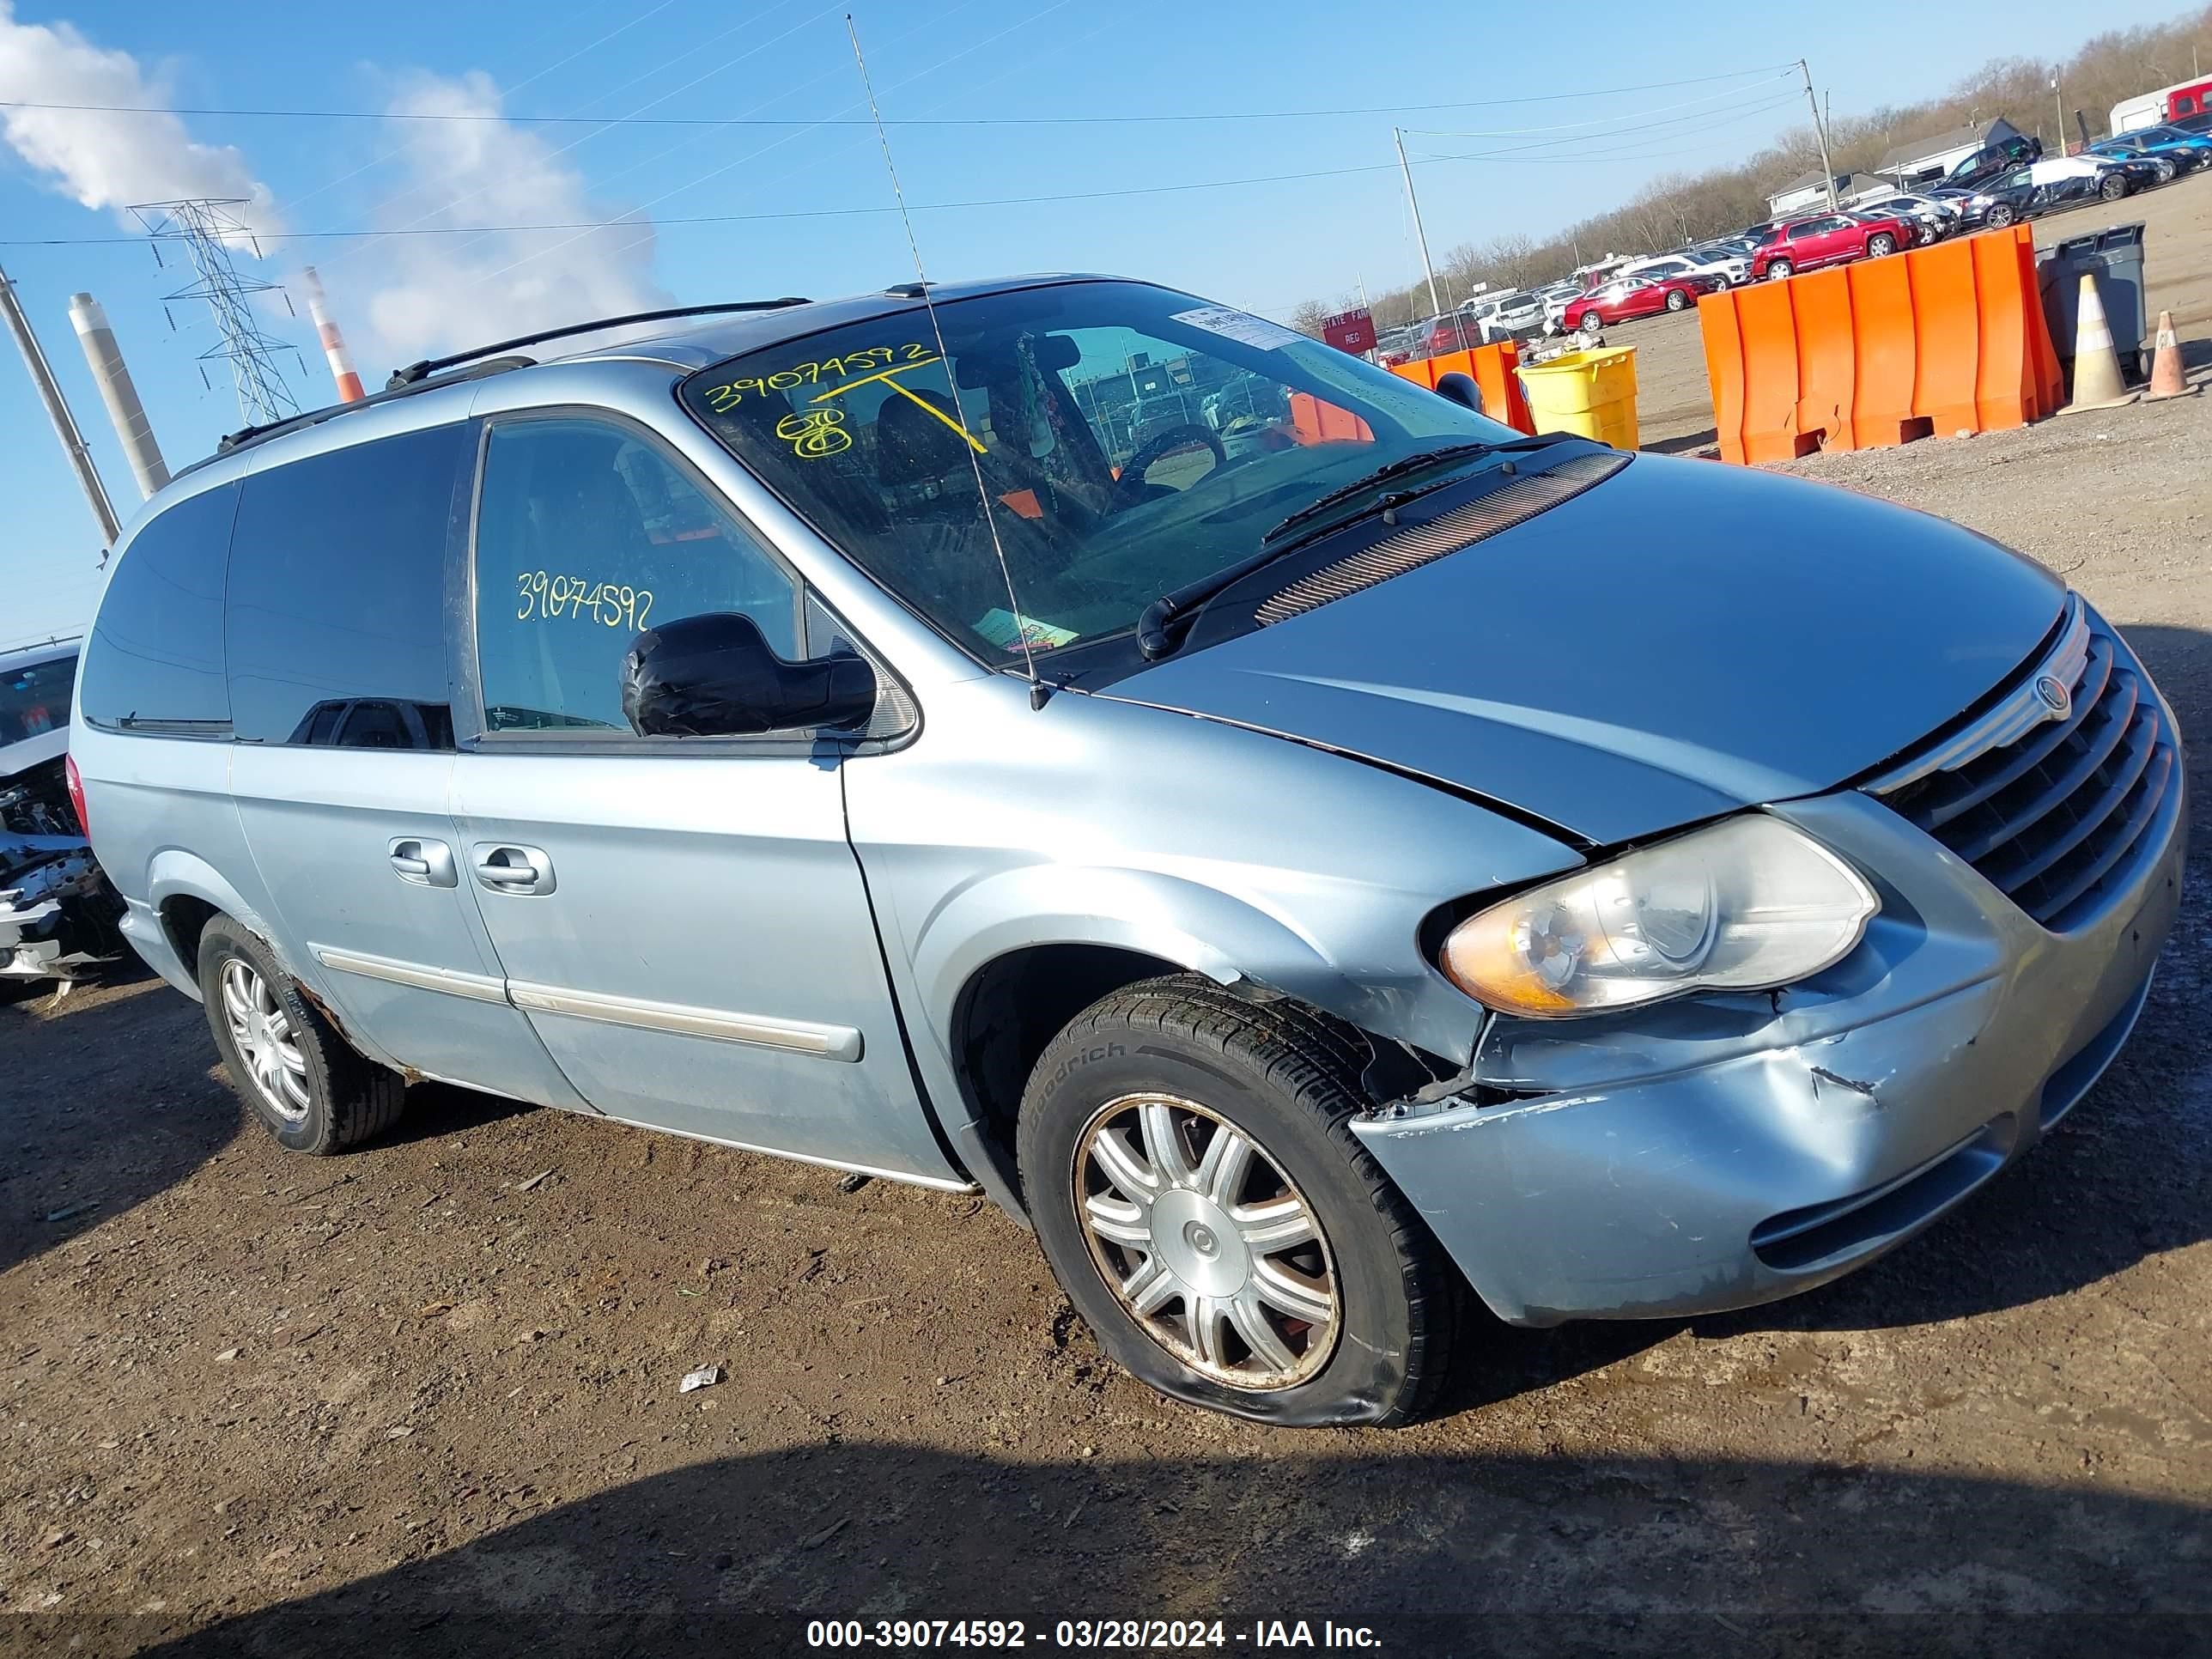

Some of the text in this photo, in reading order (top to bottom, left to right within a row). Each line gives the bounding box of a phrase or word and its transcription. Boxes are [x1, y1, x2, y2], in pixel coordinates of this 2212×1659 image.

[1321, 314, 1346, 330] STATE
[705, 343, 933, 413] 39074592
[517, 570, 653, 632] 39074592
